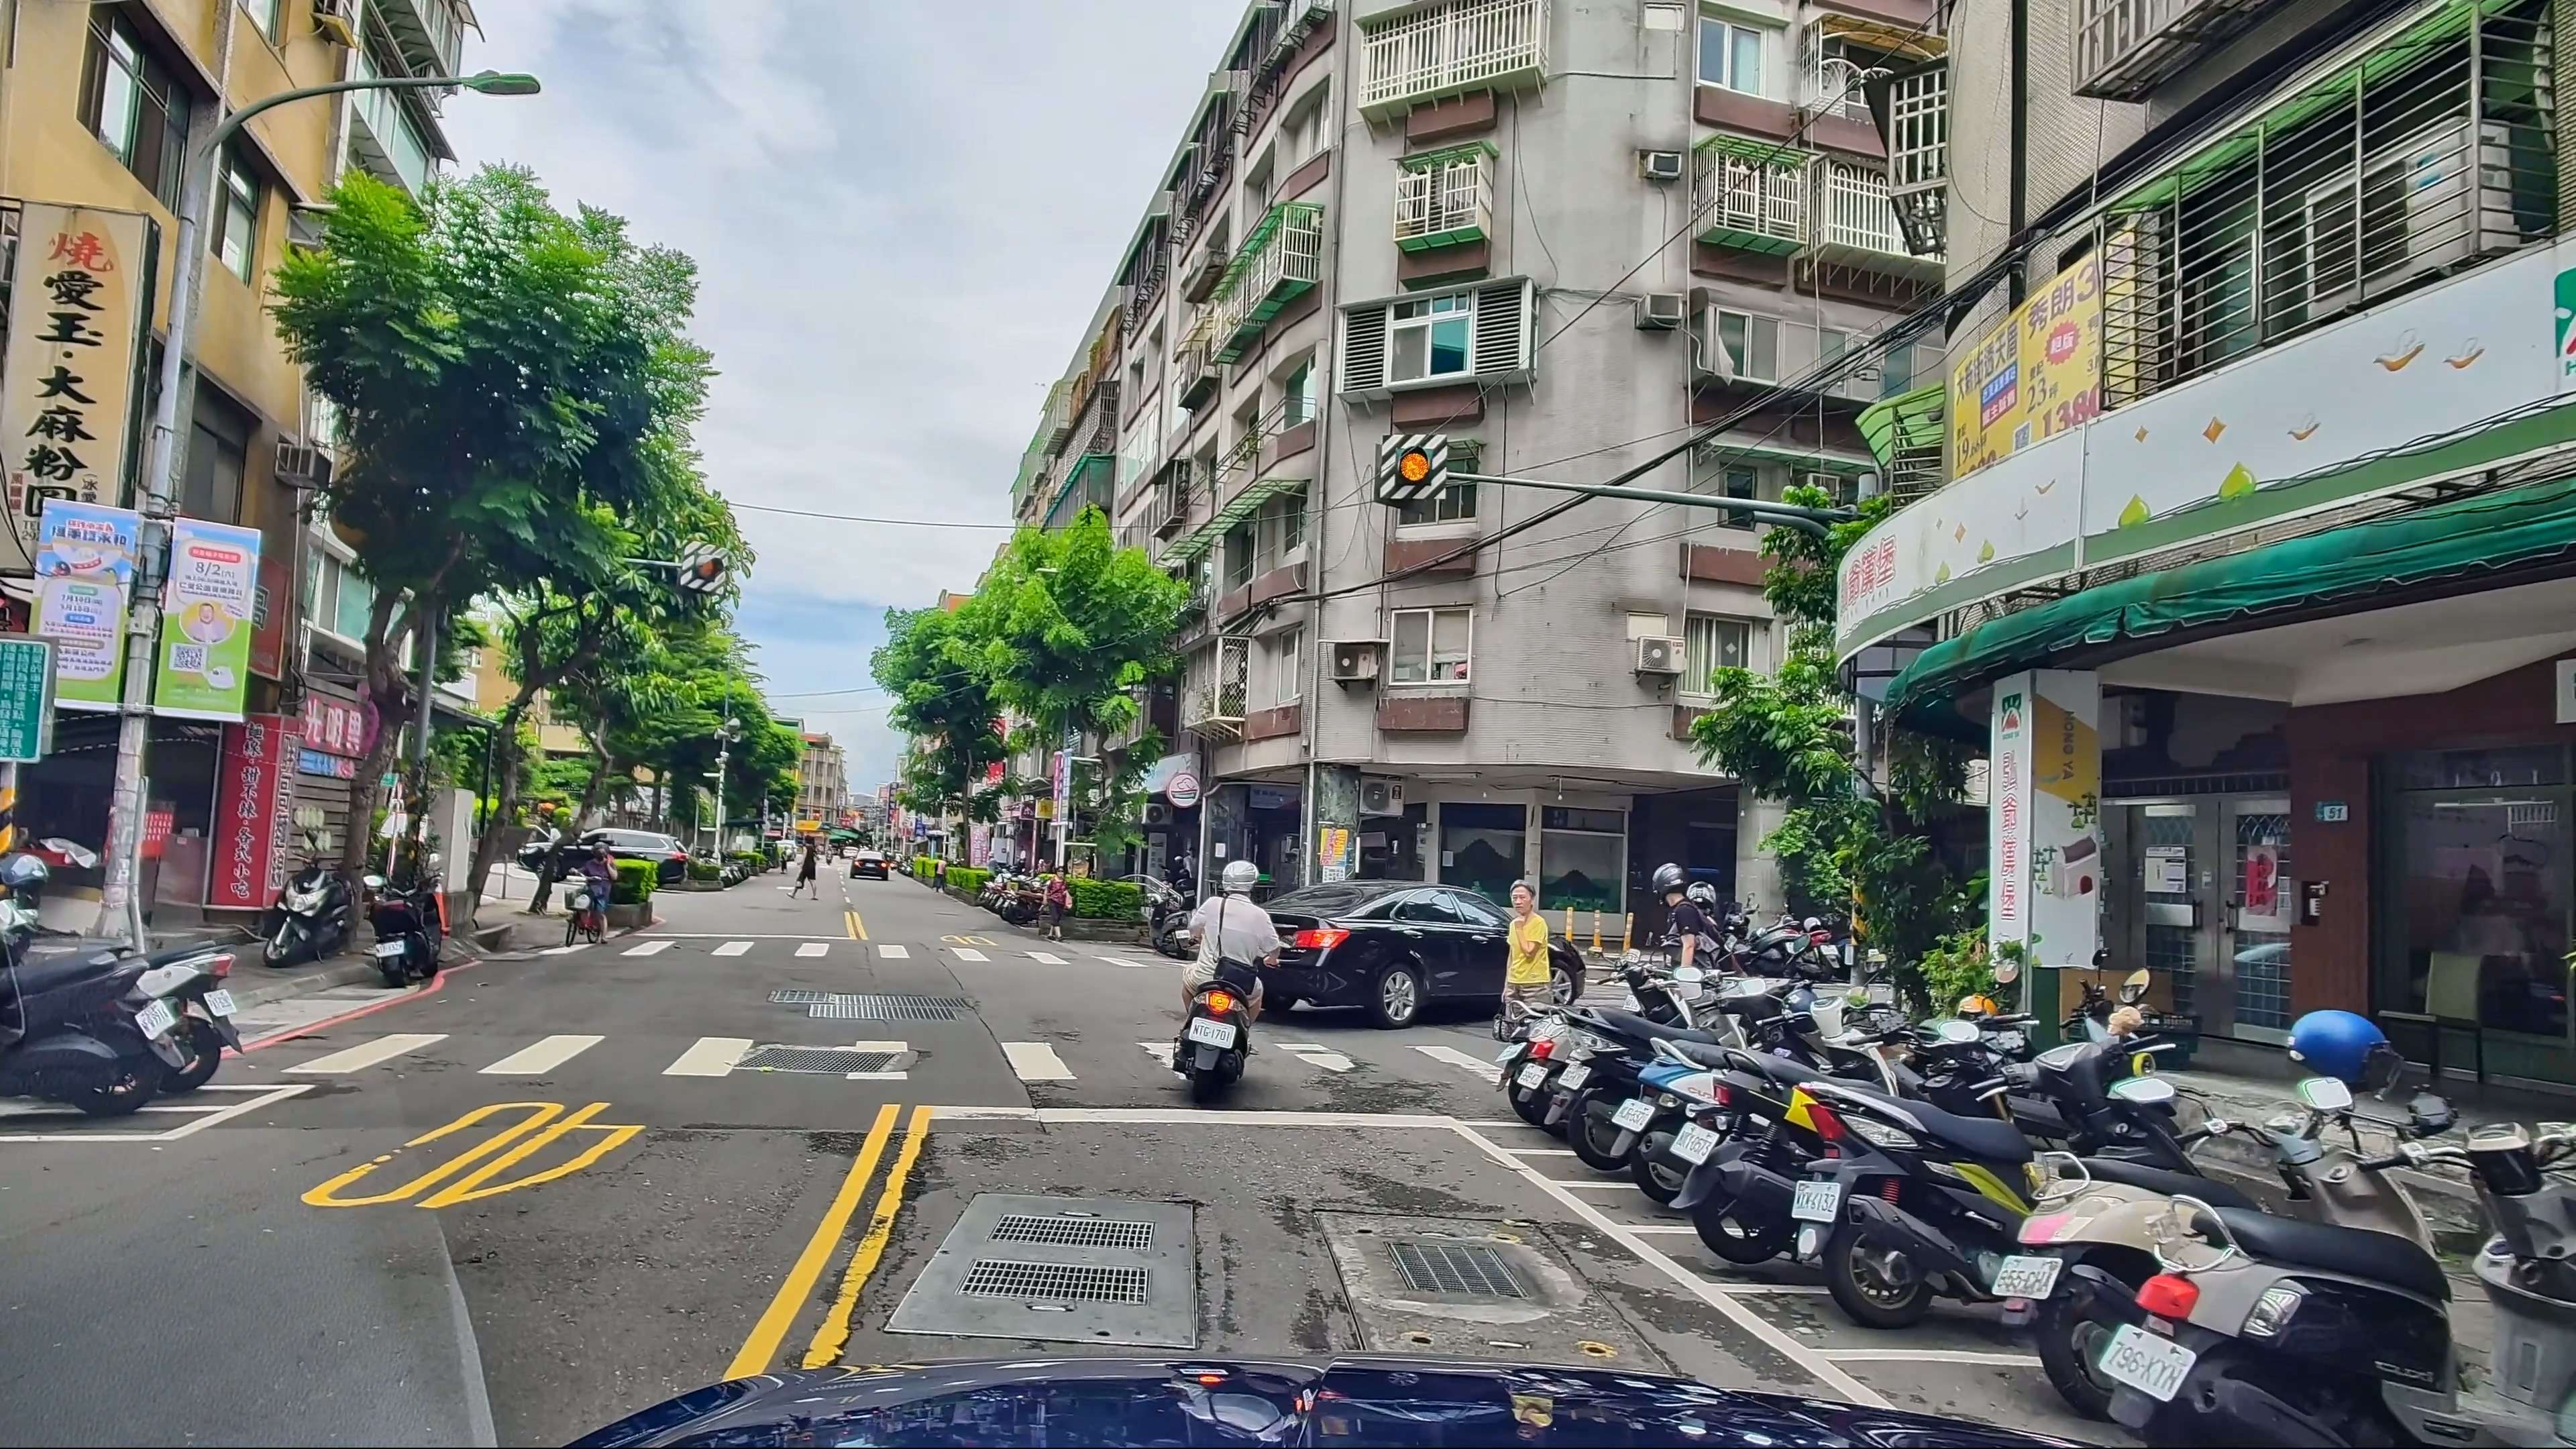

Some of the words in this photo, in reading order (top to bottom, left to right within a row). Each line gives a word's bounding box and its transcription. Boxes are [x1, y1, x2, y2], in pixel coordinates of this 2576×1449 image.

[2062, 710, 2076, 759] HONG
[2062, 761, 2074, 780] YA
[2327, 806, 2345, 820] 51
[1193, 1024, 1230, 1042] NTG-1701
